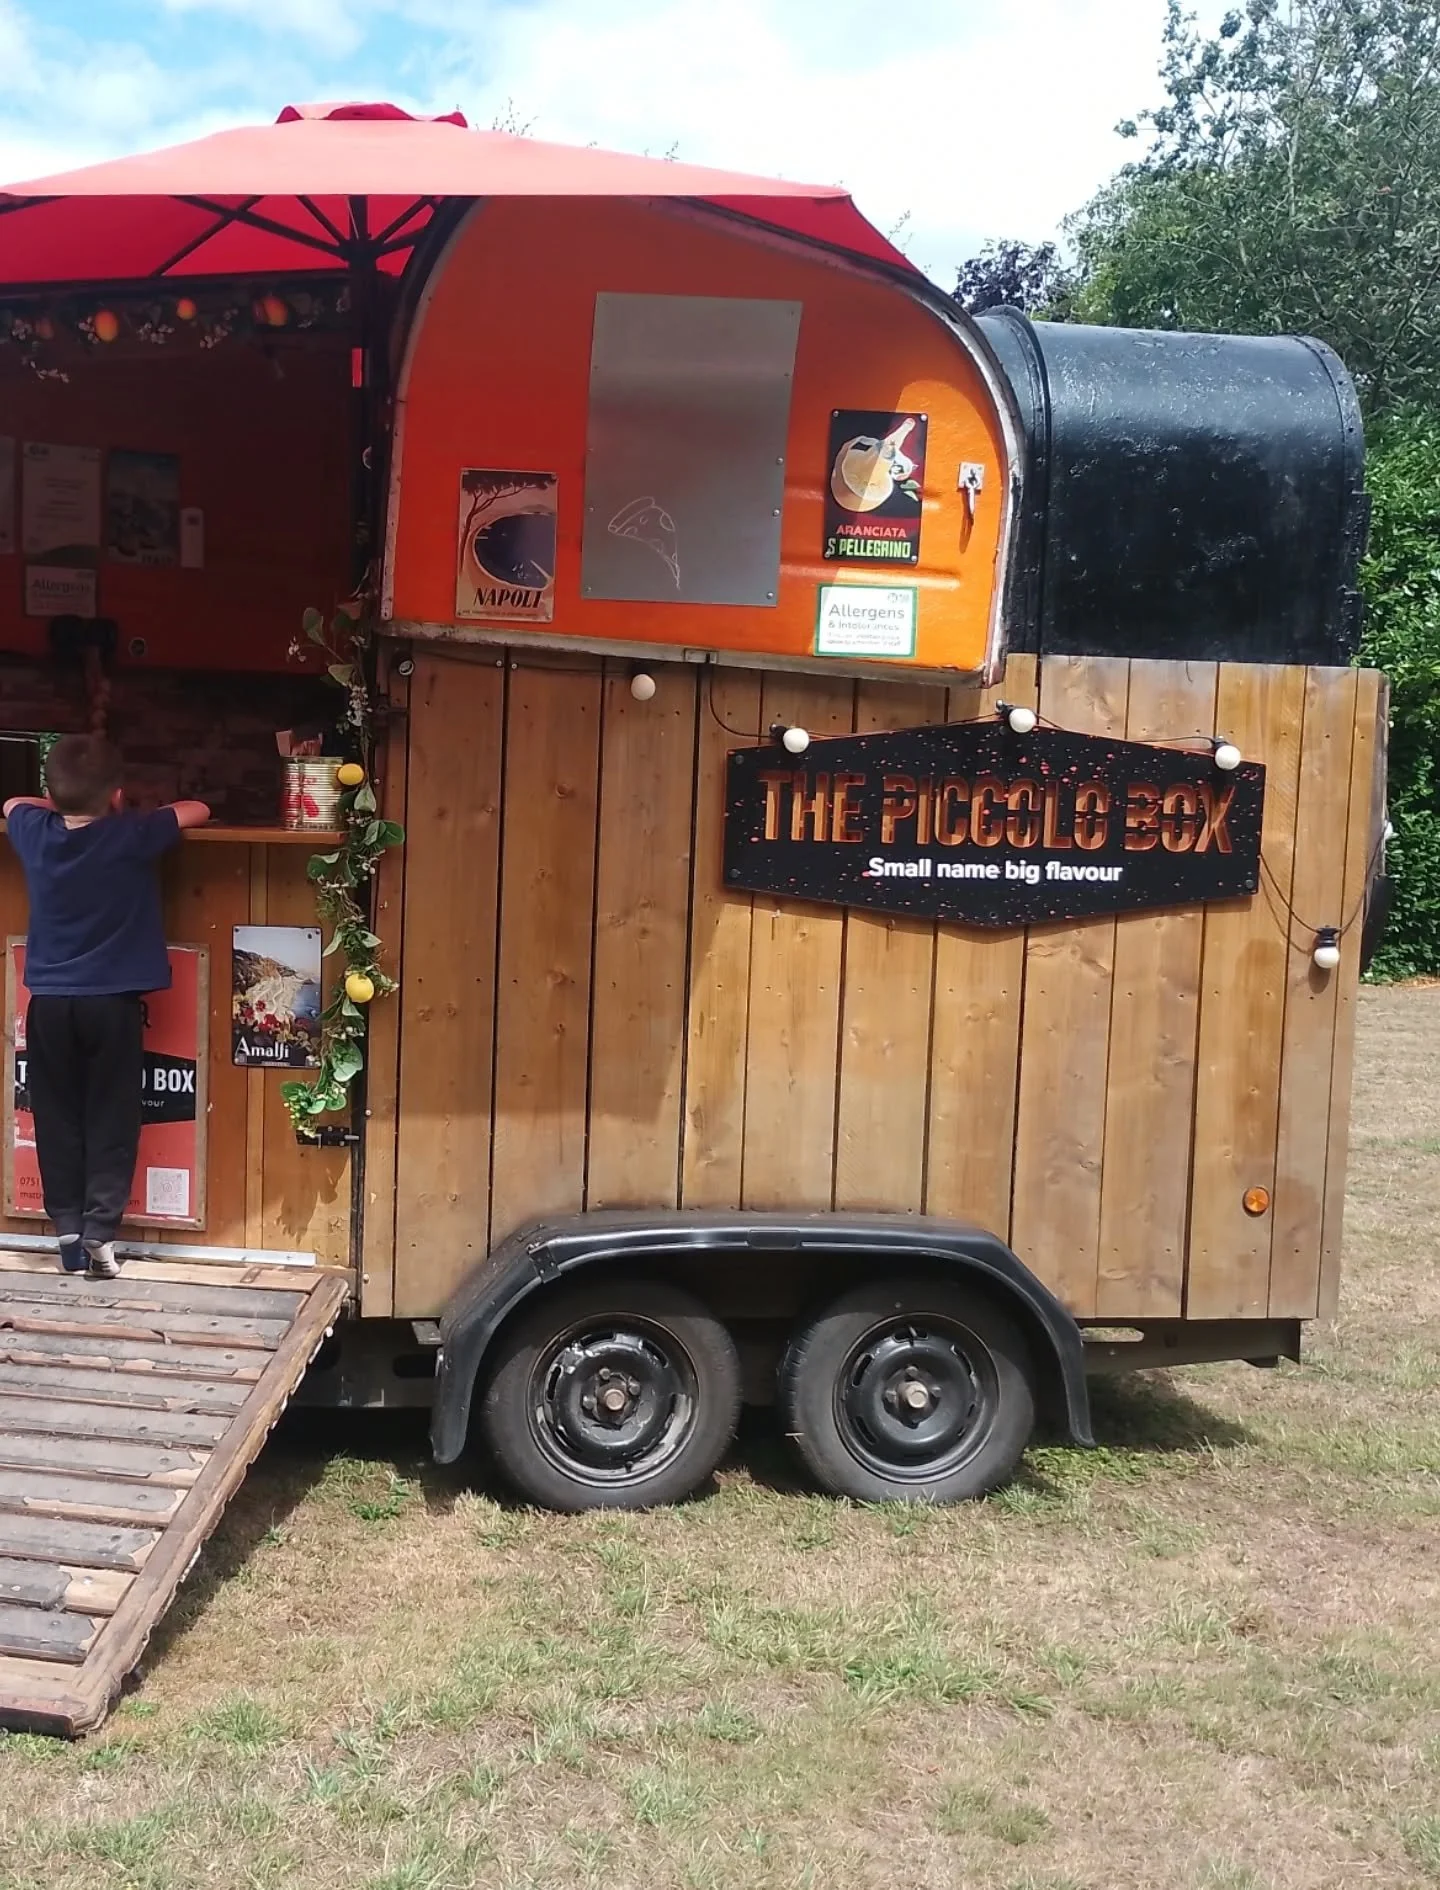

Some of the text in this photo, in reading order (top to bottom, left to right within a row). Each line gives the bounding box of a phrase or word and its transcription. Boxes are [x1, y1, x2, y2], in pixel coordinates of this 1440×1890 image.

[836, 524, 907, 539] ARANCIATA
[838, 538, 912, 558] PELLEGRINO
[32, 577, 91, 594] Allergens
[473, 587, 543, 608] NAPOLI
[828, 603, 905, 621] Allergens
[757, 768, 1236, 855] THE PICCOLO BOX
[868, 856, 1124, 884] Small name big flavour
[234, 1036, 290, 1061] Amalfi
[153, 1067, 195, 1093] BOX
[141, 1100, 165, 1109] vour
